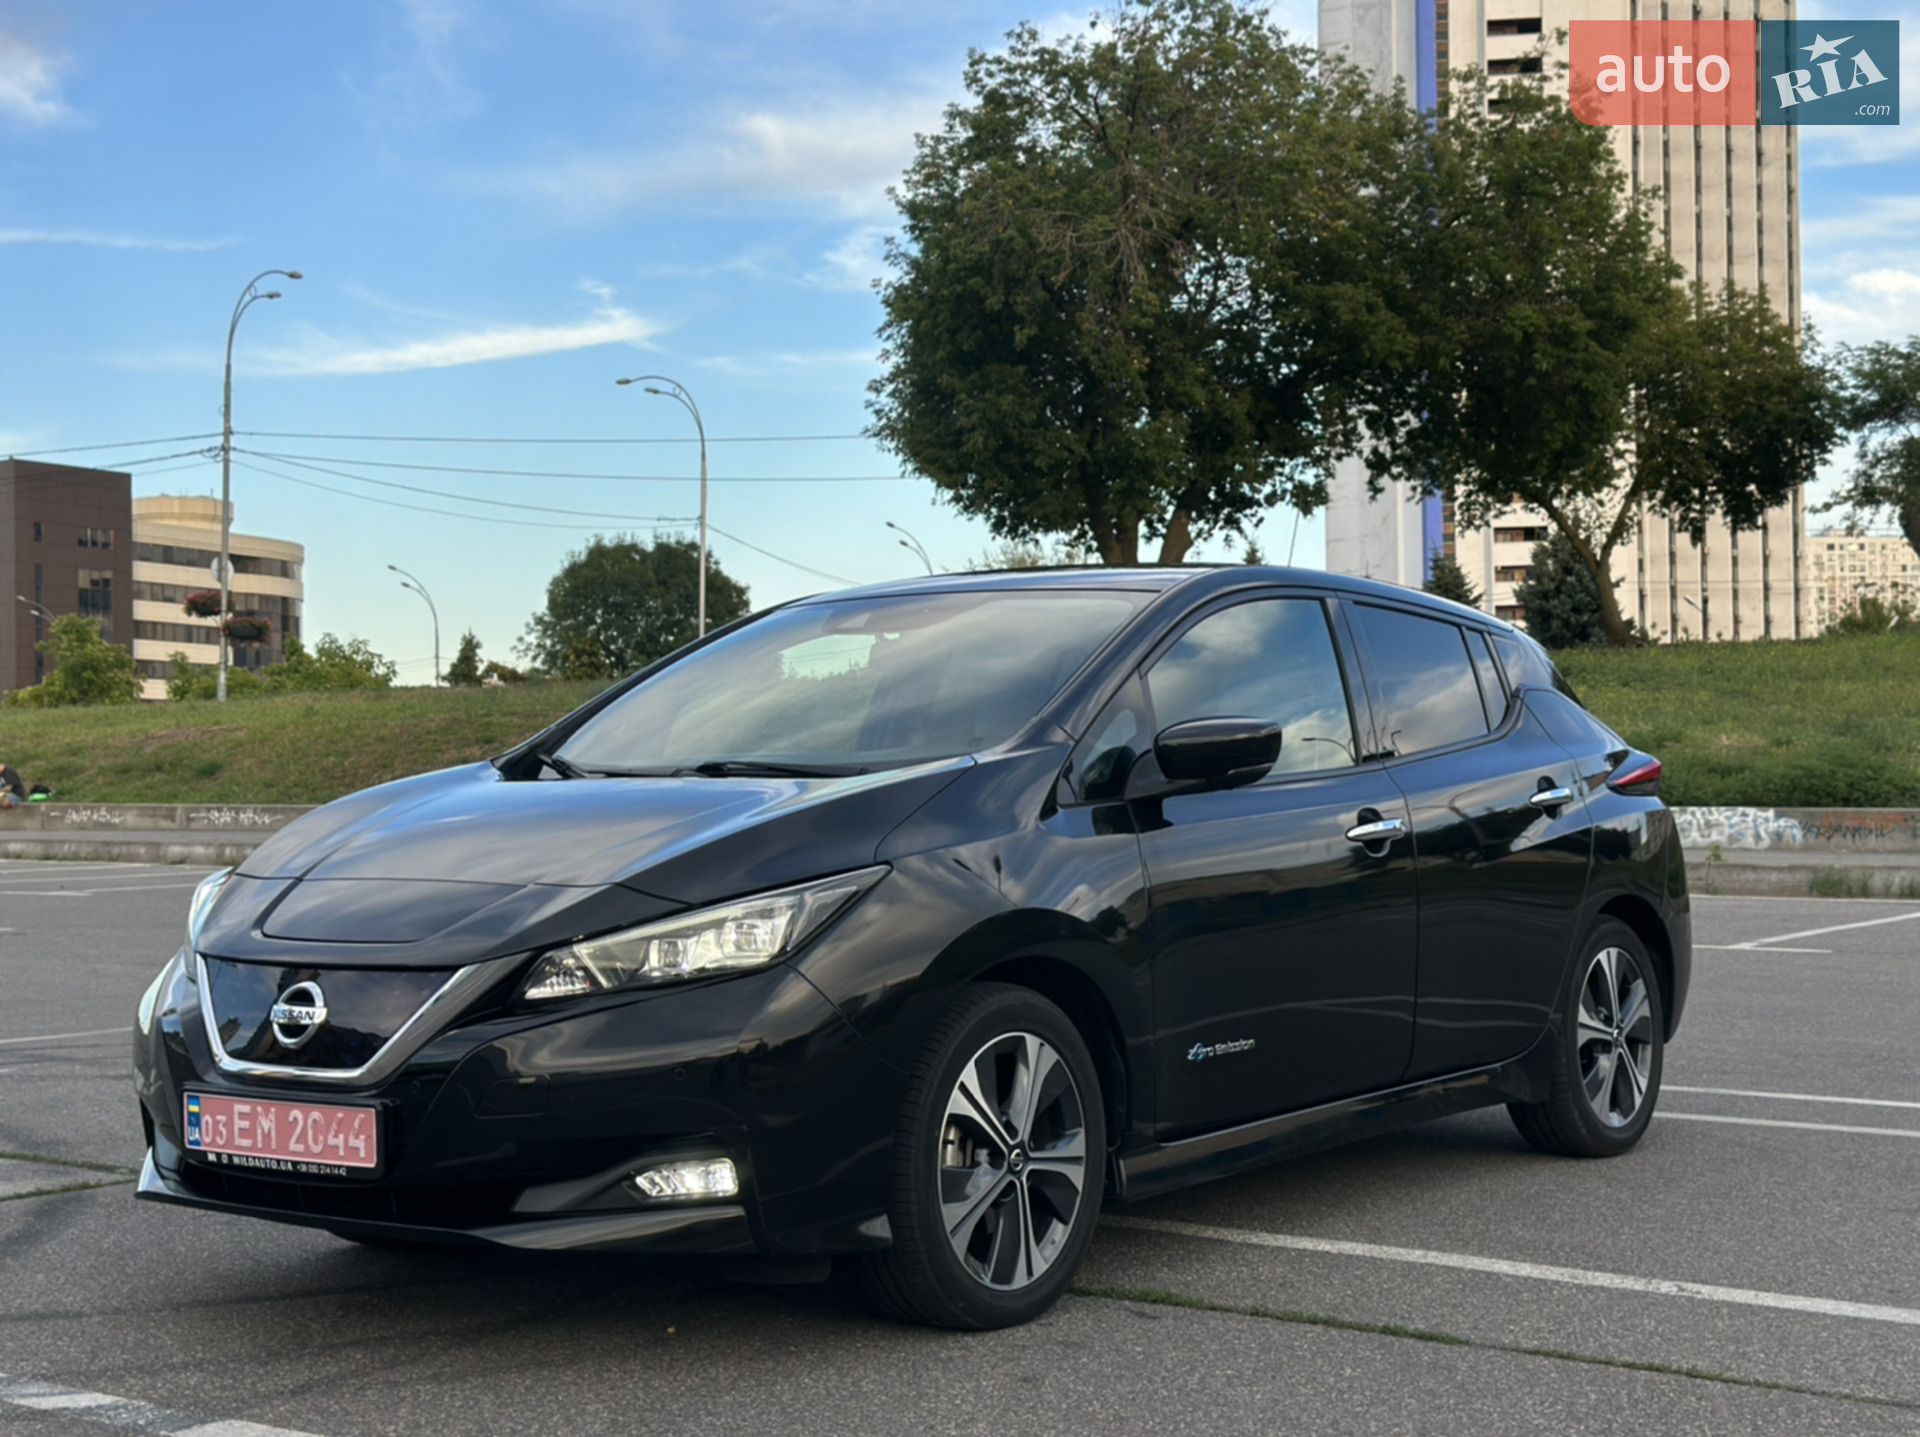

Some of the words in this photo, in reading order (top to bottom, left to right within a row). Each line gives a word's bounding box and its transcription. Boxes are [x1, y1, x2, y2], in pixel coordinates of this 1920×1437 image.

[188, 1126, 200, 1141] UA
[202, 1114, 227, 1146] 03
[233, 1104, 277, 1150] EM
[288, 1109, 366, 1158] 2044
